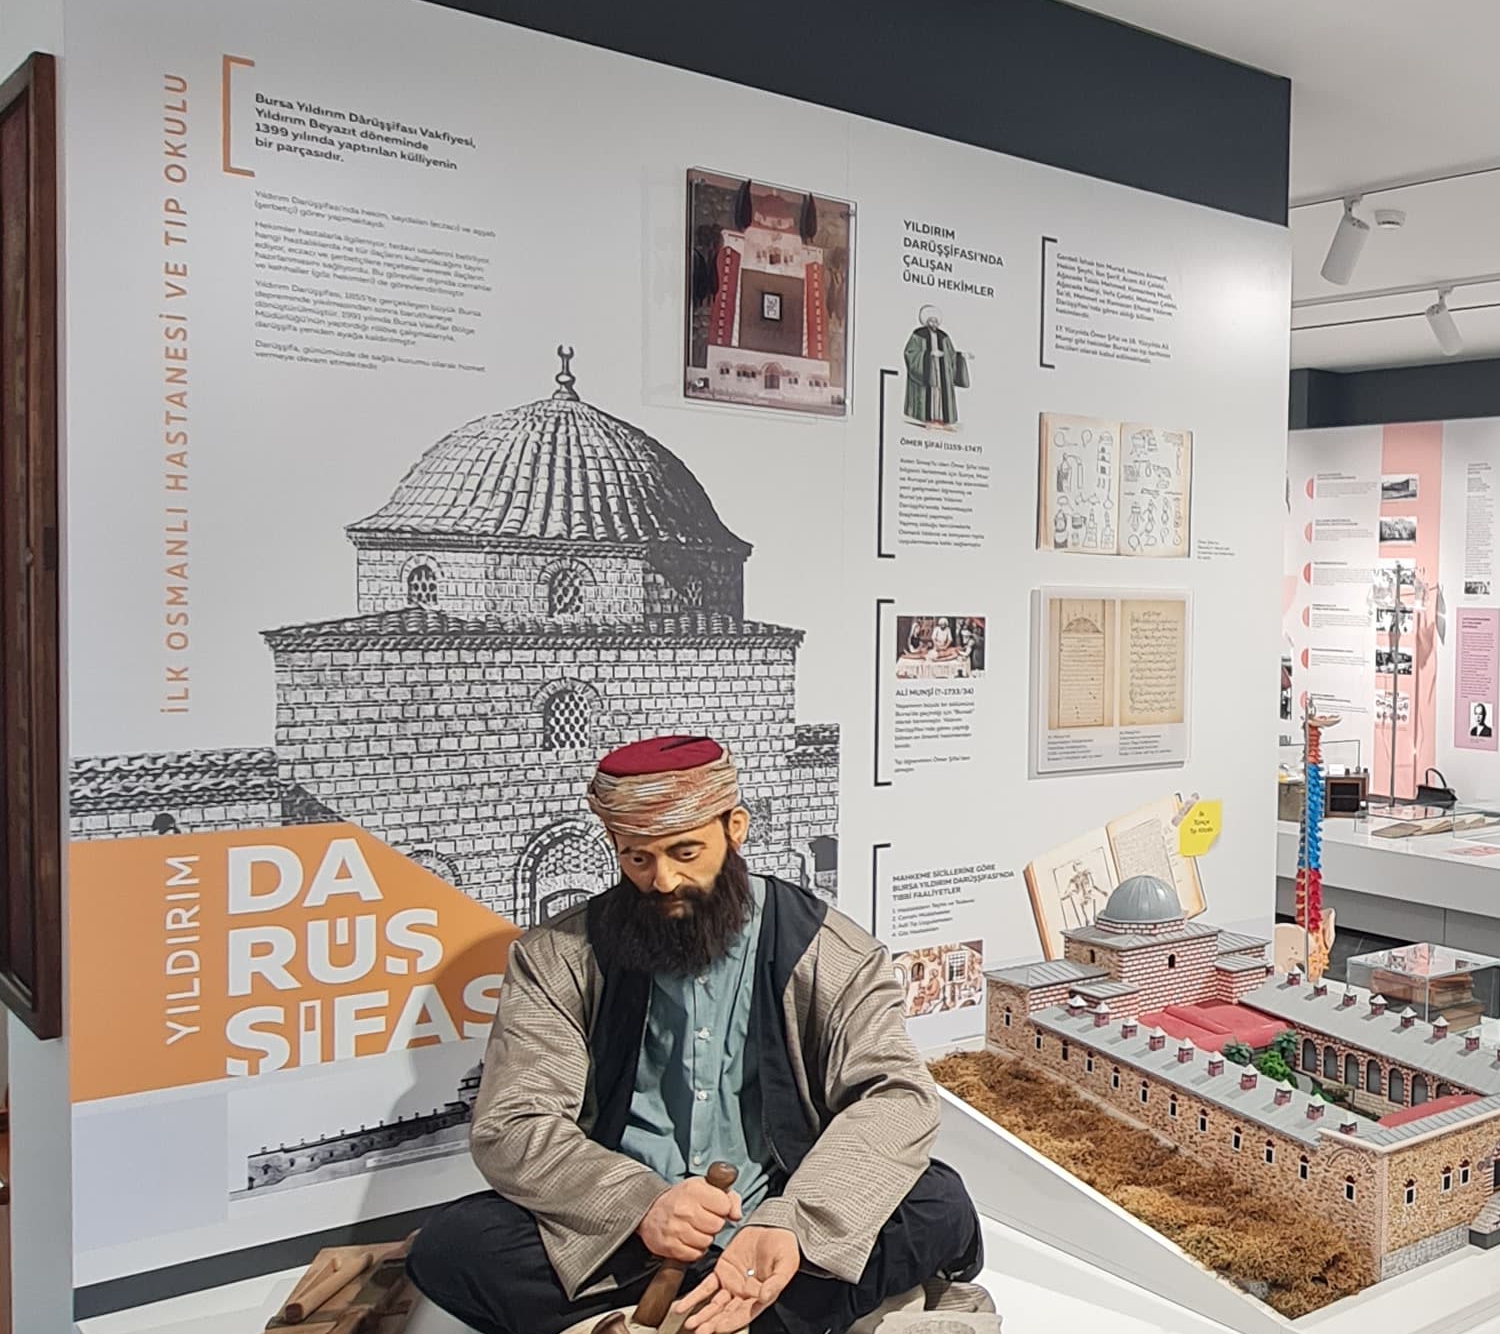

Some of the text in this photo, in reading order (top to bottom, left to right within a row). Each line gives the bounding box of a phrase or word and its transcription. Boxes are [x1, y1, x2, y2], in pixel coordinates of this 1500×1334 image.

[255, 93, 293, 110] Bursa
[296, 102, 345, 120] Yıldırım
[420, 127, 476, 149] Vakfiyesi,
[255, 108, 429, 151] Yıldırım Beyazıt döneminde
[255, 123, 457, 169] 1399 yılında yaptırılan külliyenin
[255, 137, 344, 162] bir parçasıdır.
[904, 219, 955, 240] YILDIRIM
[903, 255, 952, 273] ÇALIŞAN
[903, 269, 994, 298] ÜNLÜ HEKİMLER
[158, 73, 189, 713] İLK OSMANLI HASTANESİ VE TIP OKULU
[227, 837, 384, 915] DA
[166, 854, 200, 1046] YILDIRIM
